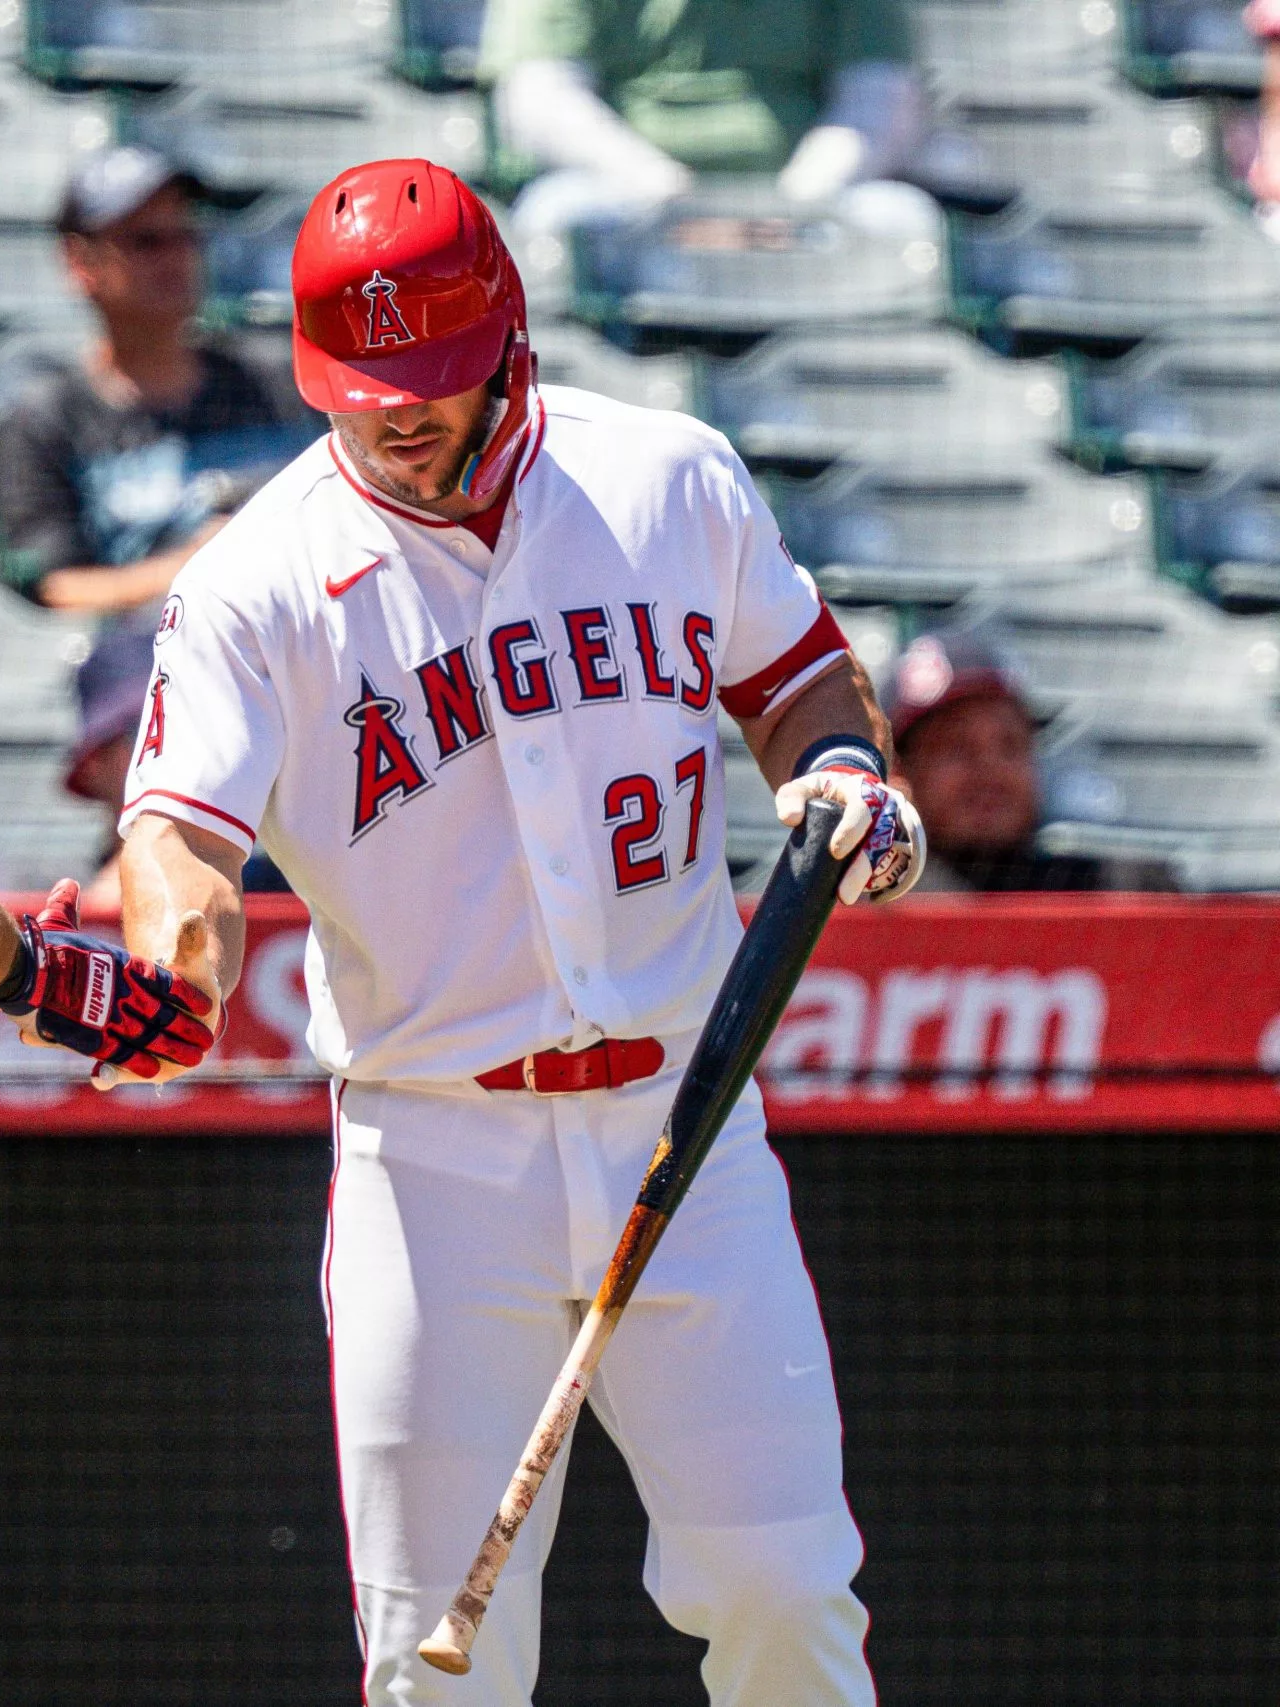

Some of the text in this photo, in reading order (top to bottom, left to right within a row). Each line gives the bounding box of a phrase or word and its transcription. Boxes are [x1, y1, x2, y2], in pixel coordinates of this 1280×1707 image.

[362, 270, 416, 348] A
[136, 664, 170, 767] A
[344, 601, 717, 847] ANGELS
[602, 745, 707, 896] 27
[87, 955, 111, 1023] Franklin
[762, 966, 1108, 1103] arm
